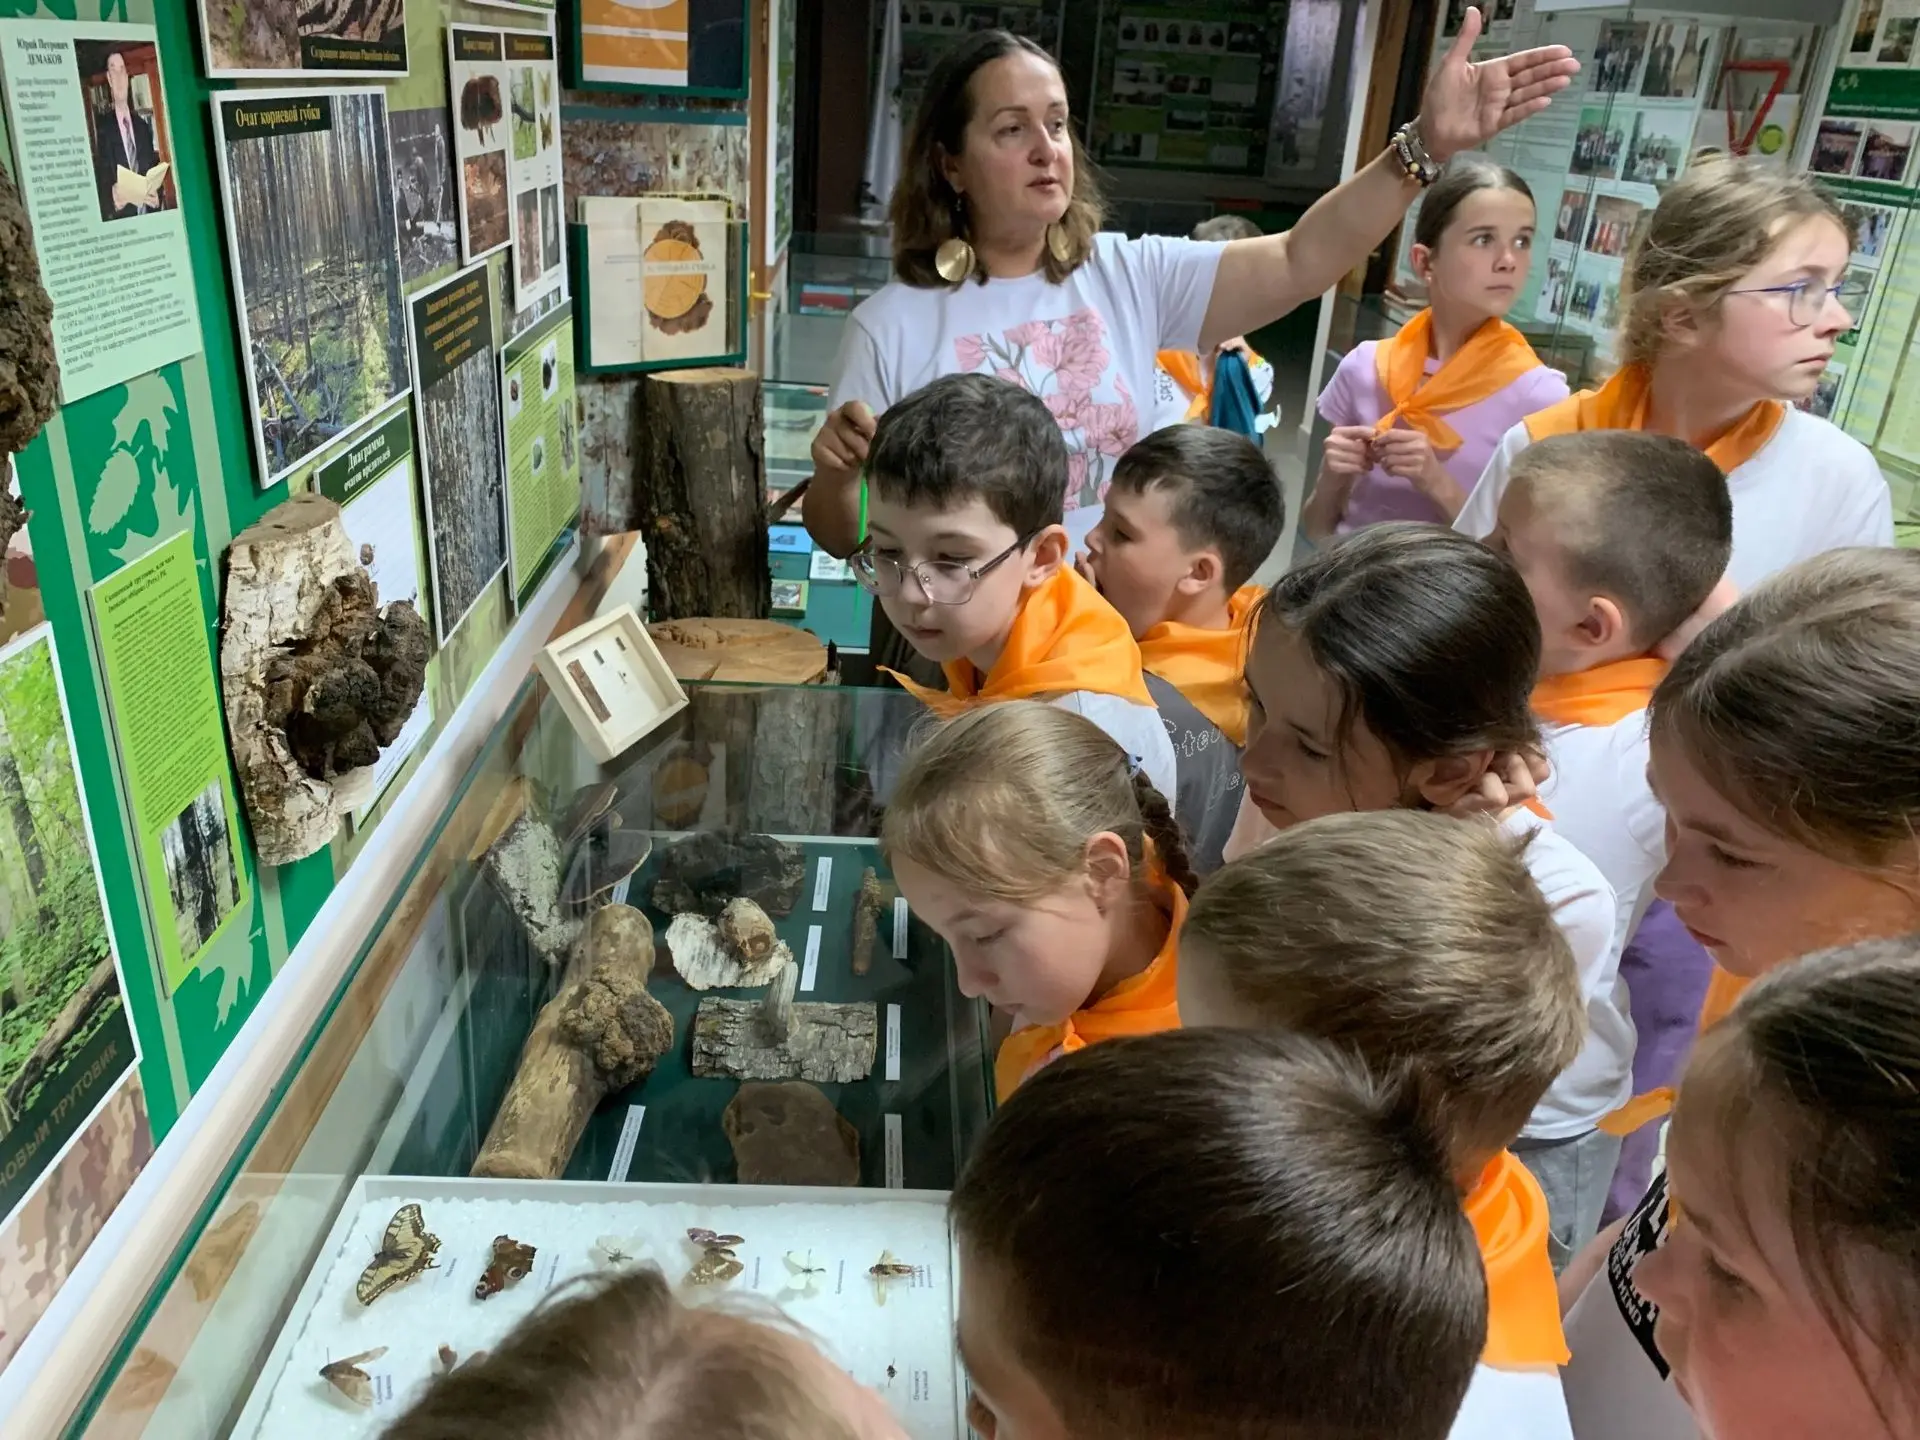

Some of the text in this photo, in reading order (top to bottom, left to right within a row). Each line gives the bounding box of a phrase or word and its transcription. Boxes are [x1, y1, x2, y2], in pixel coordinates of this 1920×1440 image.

[235, 103, 321, 129] Очаг корневой губки
[348, 434, 385, 474] Диаграмма
[50, 1041, 118, 1125] ТРУТОВИК
[1617, 1279, 1642, 1326] MIND
